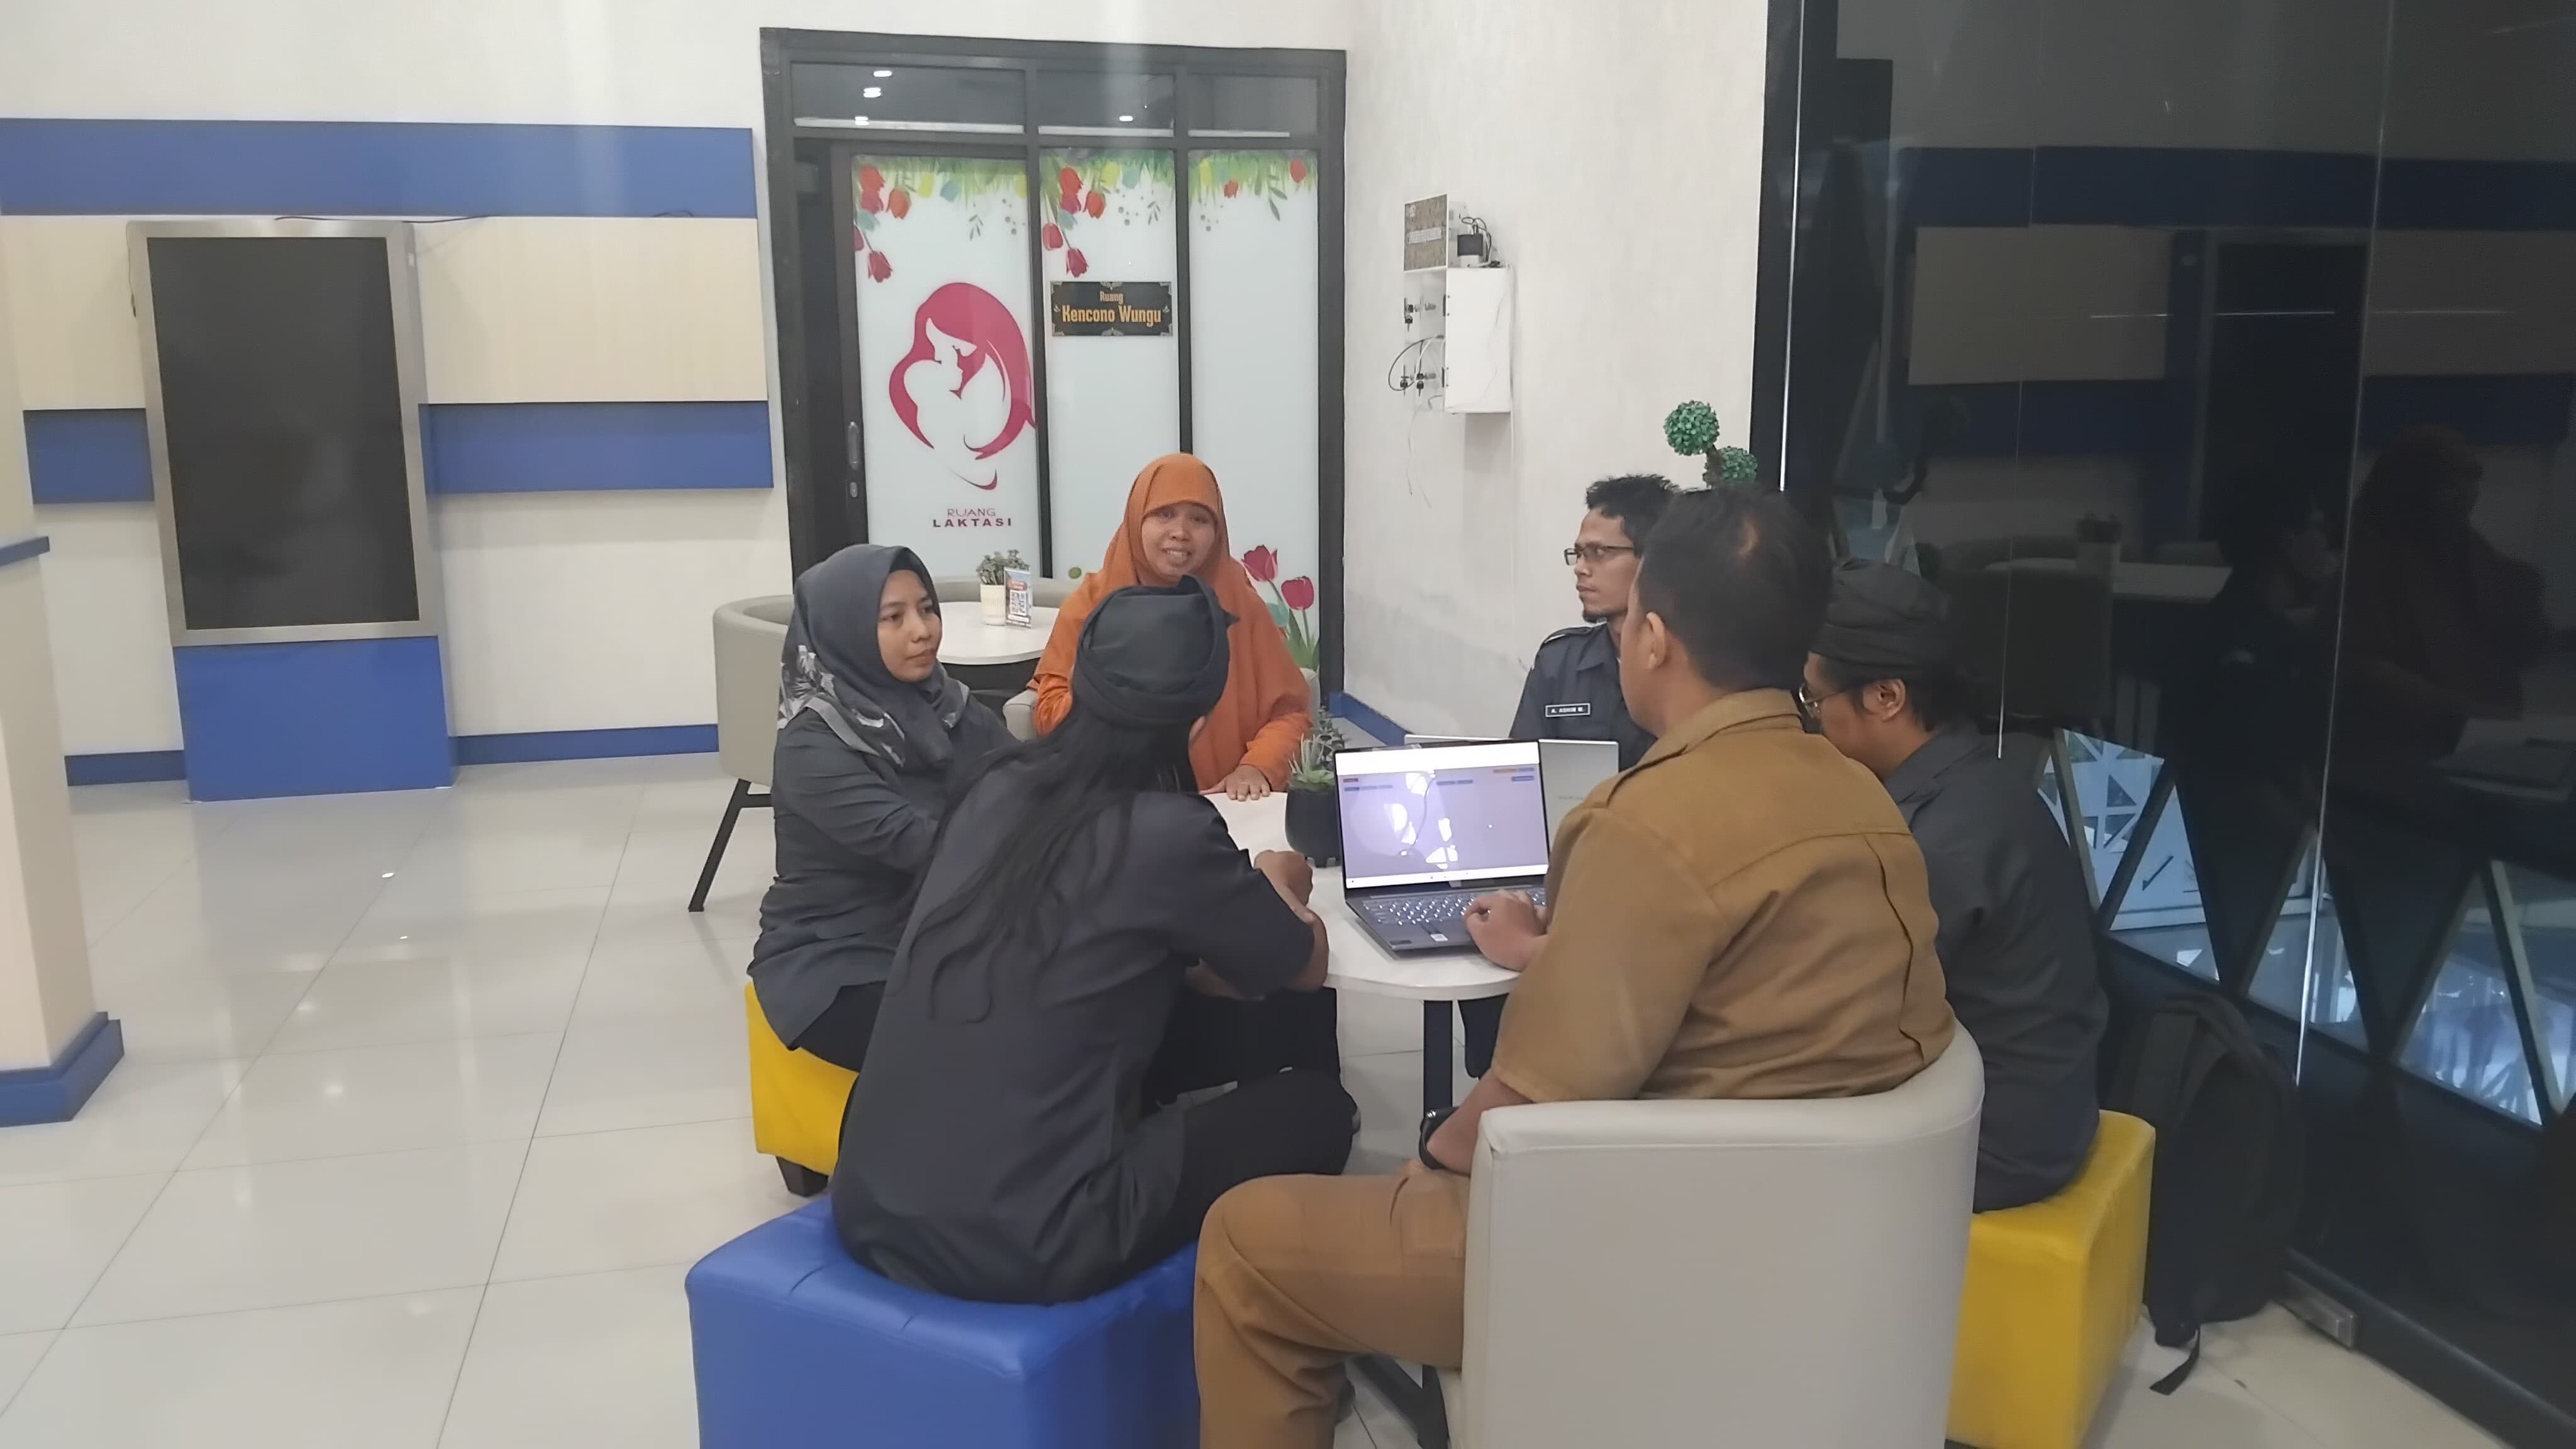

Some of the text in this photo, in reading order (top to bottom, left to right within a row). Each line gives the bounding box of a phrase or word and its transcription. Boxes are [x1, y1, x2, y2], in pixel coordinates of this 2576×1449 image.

[1100, 291, 1124, 304] Ruang
[1062, 305, 1162, 327] Kencono Wungu
[947, 508, 996, 517] RUANG
[933, 518, 1011, 528] LAKTASI
